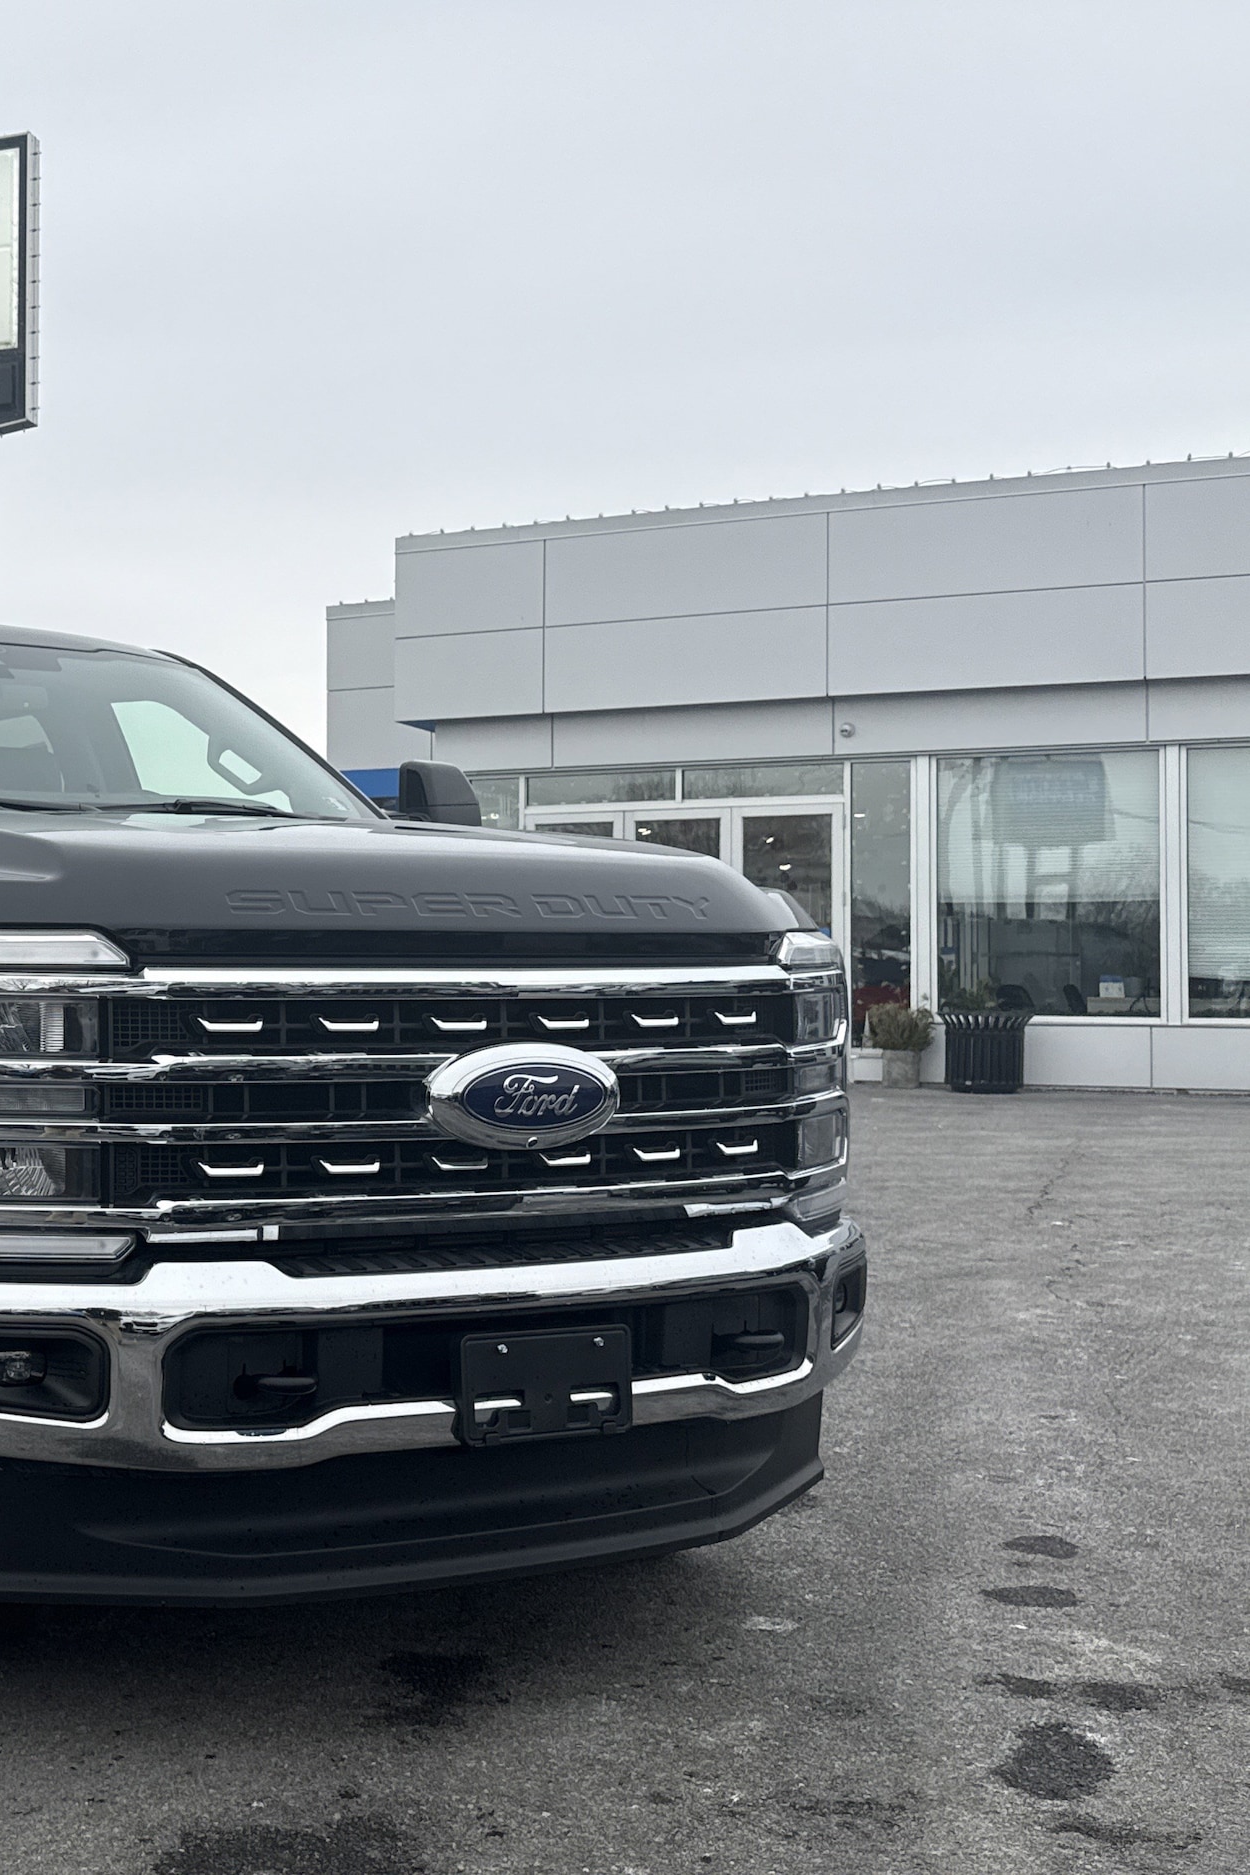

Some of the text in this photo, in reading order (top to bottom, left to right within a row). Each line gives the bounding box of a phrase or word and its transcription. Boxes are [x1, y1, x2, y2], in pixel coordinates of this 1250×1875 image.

[225, 888, 710, 920] SUPER DUTY
[493, 1073, 581, 1118] Ford
